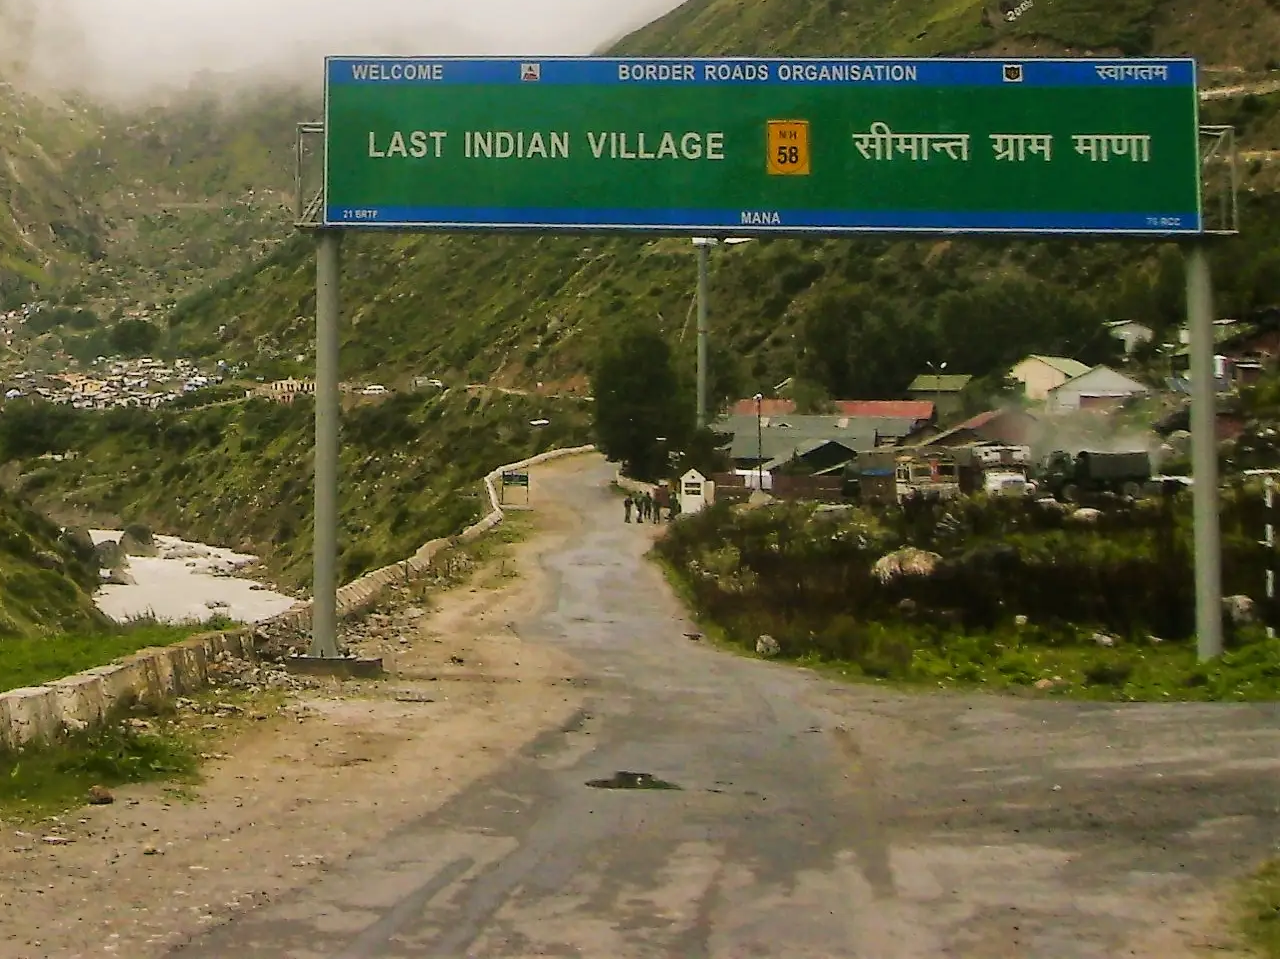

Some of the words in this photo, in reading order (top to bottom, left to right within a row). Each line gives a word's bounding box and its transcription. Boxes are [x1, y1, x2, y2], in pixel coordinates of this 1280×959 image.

[352, 64, 443, 81] WELCOME
[618, 64, 696, 81] BORDER
[704, 64, 769, 82] ROADS
[777, 64, 917, 82] ORGANISATION
[1094, 65, 1168, 81] स्वागतम
[368, 130, 447, 158] LAST
[464, 131, 569, 159] INDIAN
[587, 131, 725, 160] VILLAGE
[852, 122, 970, 161] सीमान्त
[988, 134, 1053, 162] ग्राम
[1071, 135, 1151, 162] माणा
[777, 146, 799, 164] 58
[741, 211, 780, 224] MANA
